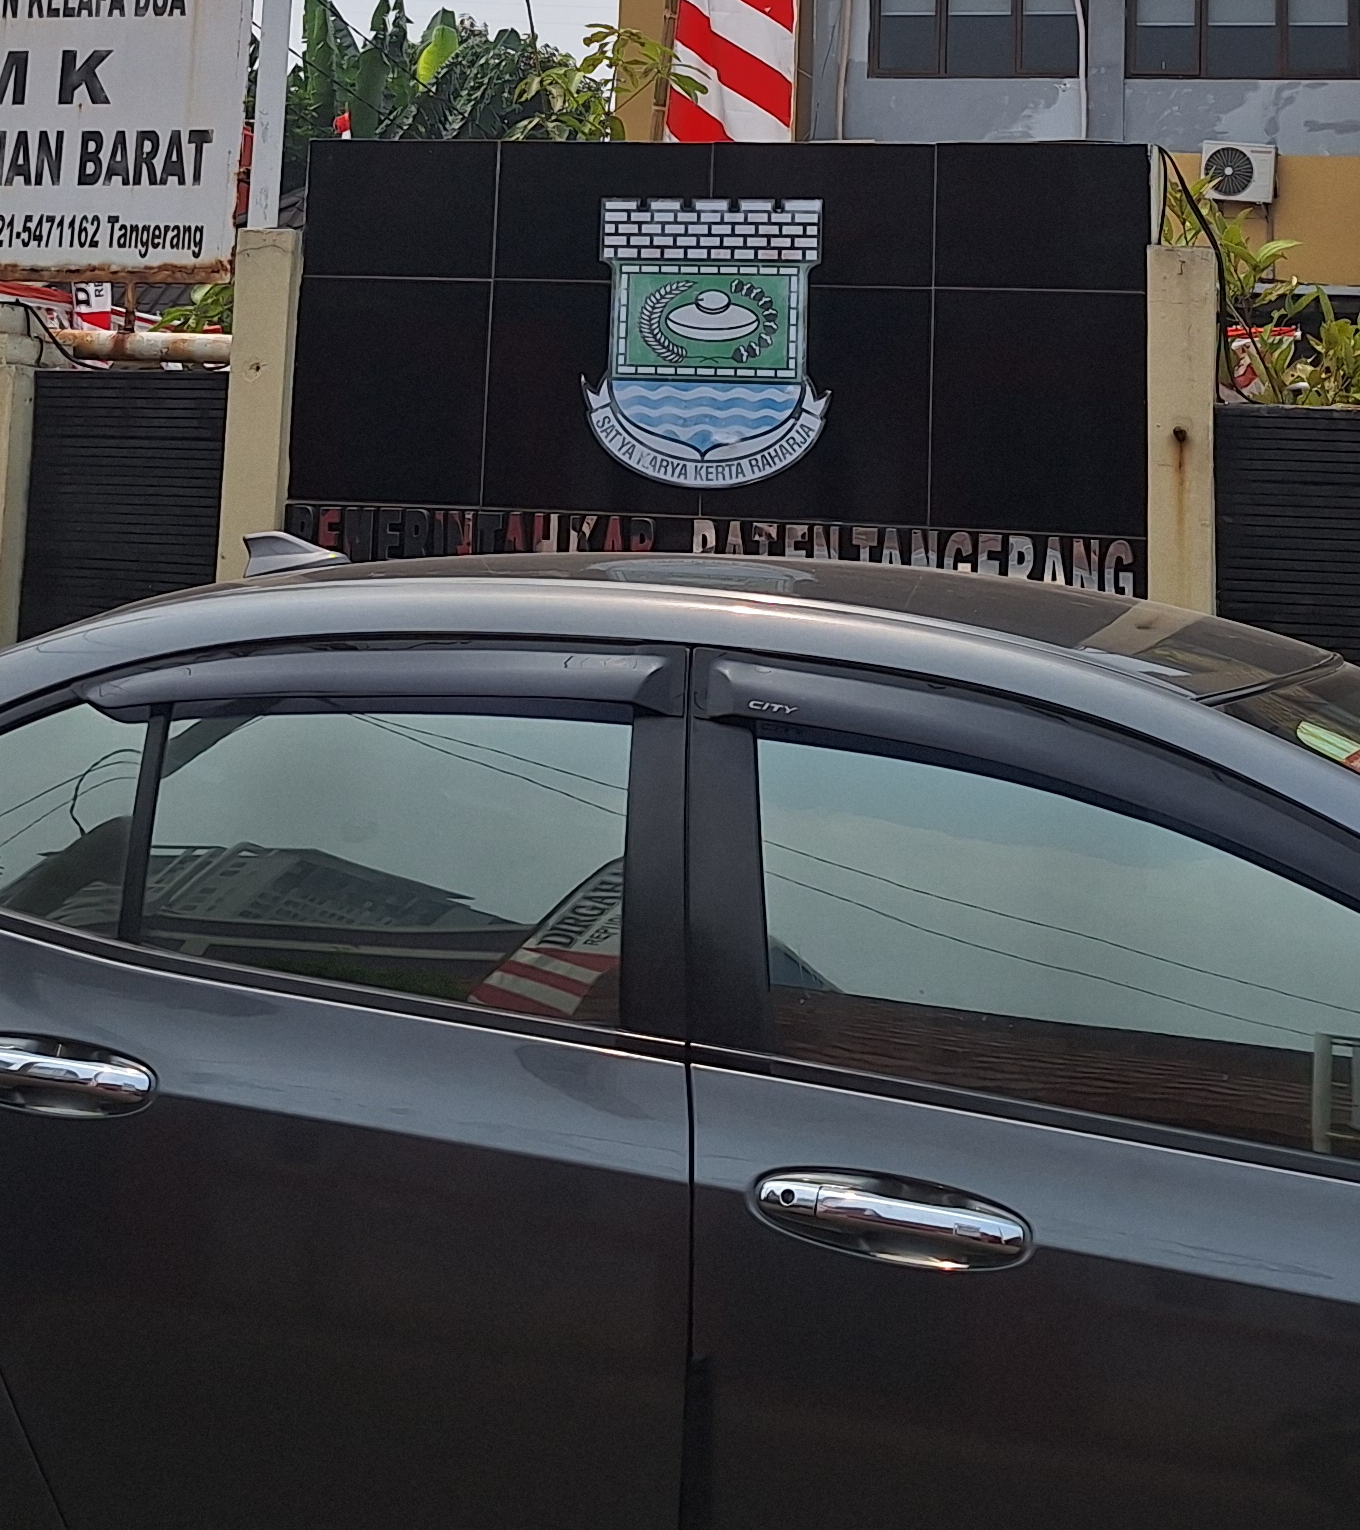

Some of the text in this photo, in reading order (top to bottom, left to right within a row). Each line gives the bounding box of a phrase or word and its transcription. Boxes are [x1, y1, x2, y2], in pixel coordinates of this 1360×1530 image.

[77, 129, 214, 187] BARAT
[107, 216, 204, 260] Tangerang
[595, 415, 638, 458] SATYA
[693, 462, 747, 482] KERTA
[749, 422, 816, 476] RAHARJA
[851, 526, 1134, 598] TANGERANG
[748, 699, 799, 714] CITY
